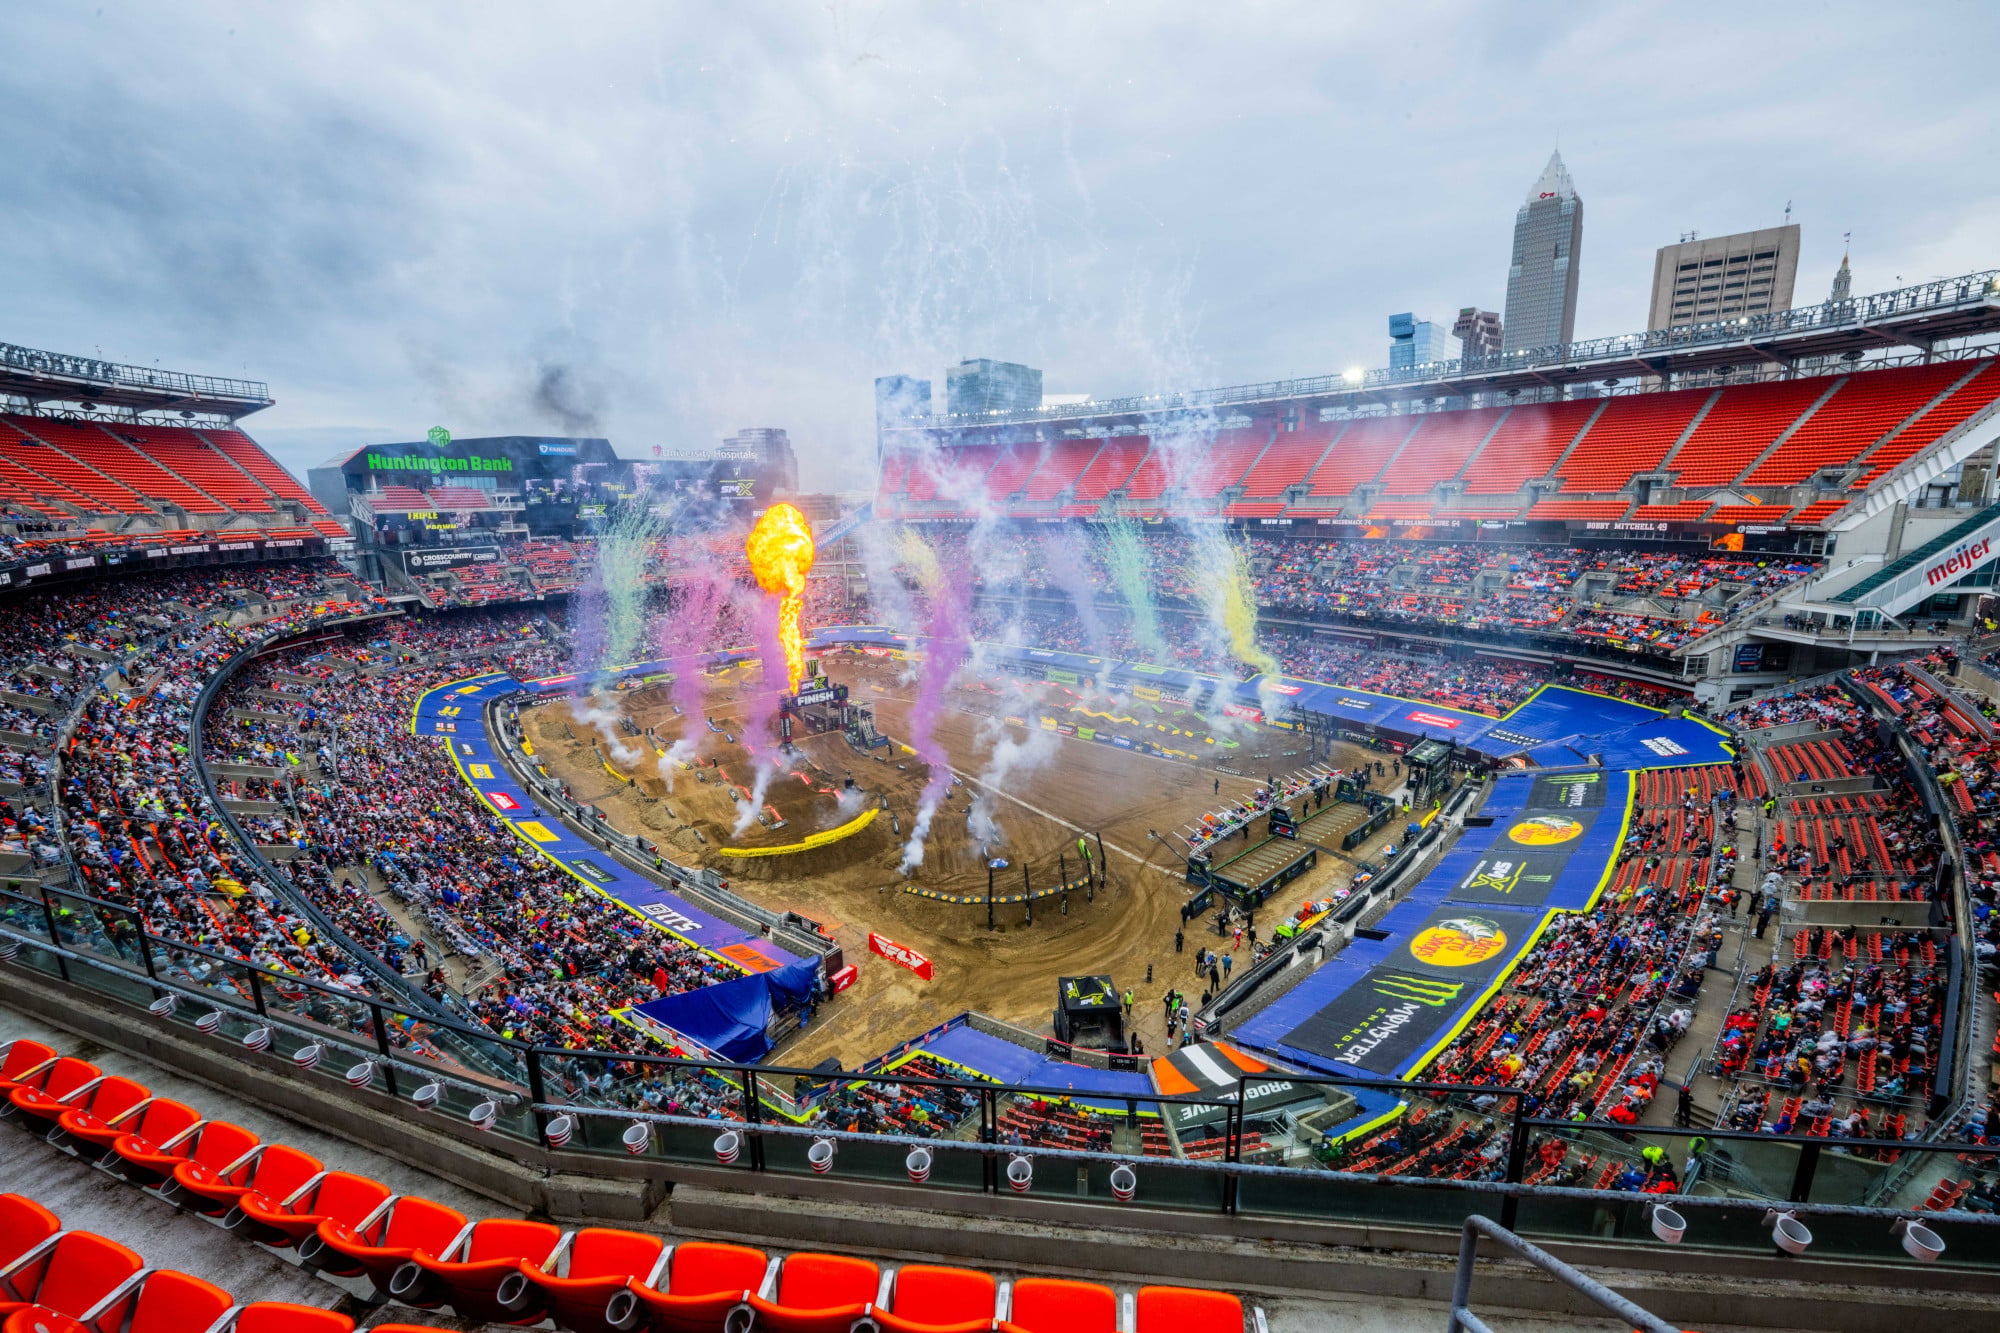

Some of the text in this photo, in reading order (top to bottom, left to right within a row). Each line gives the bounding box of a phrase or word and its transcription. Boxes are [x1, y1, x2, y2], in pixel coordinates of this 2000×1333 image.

[661, 448, 755, 461] University Hospitals
[367, 454, 513, 474] Huntington Bank
[720, 482, 754, 496] SMX
[1614, 522, 1655, 531] MITCHELL
[1657, 523, 1667, 531] 49
[423, 552, 472, 561] CROSSCOUNTRY
[1926, 536, 1990, 586] meijer
[797, 691, 834, 706] FINISH
[1334, 1007, 1387, 1049] ENERGY
[1334, 1002, 1420, 1064] MONSTER
